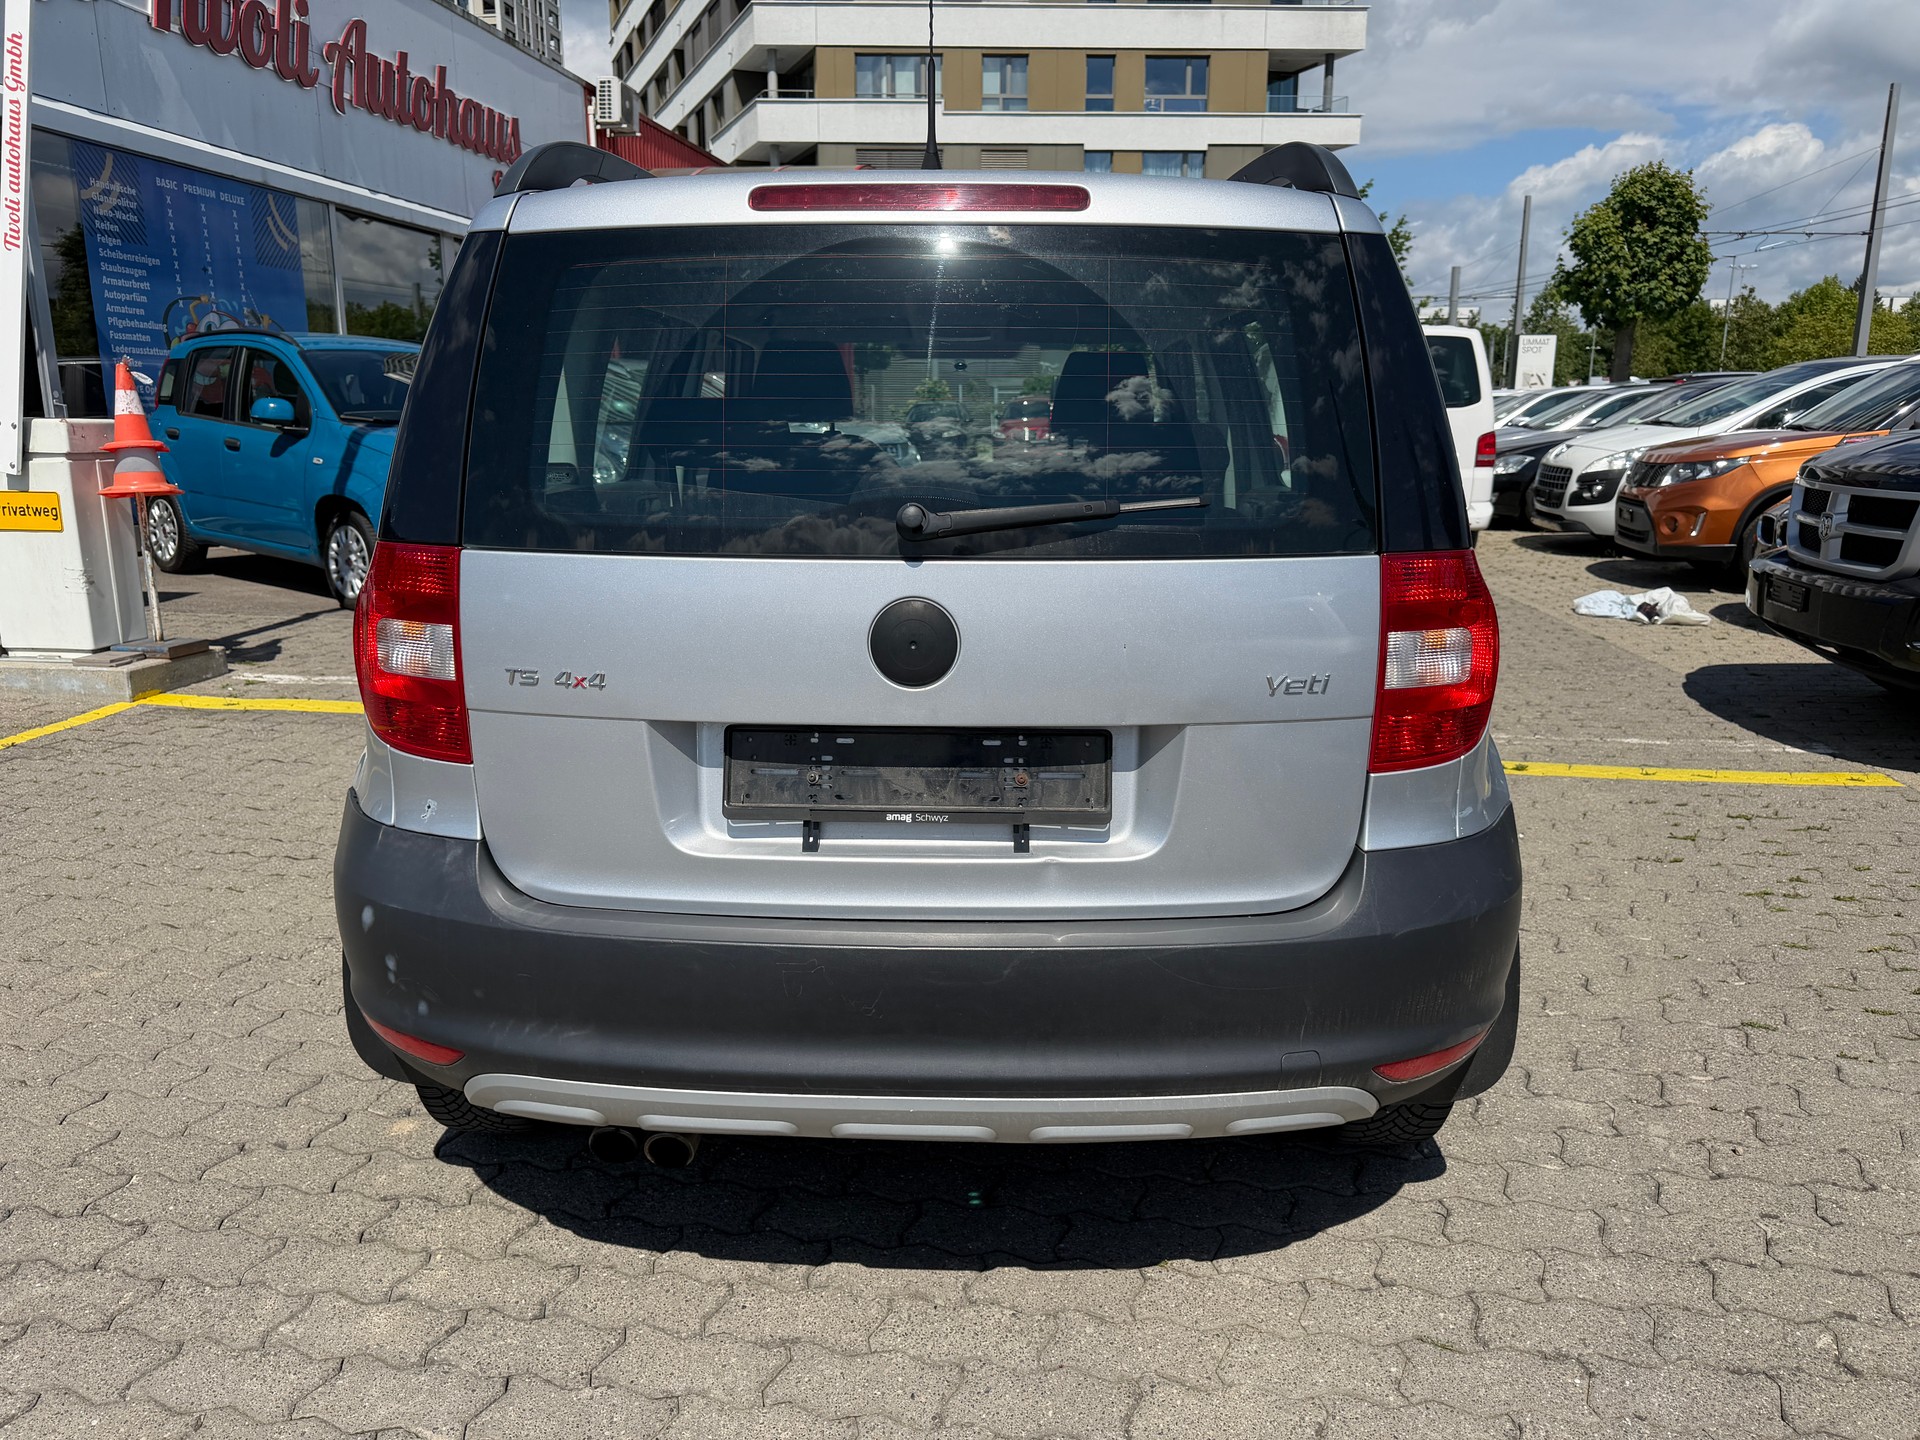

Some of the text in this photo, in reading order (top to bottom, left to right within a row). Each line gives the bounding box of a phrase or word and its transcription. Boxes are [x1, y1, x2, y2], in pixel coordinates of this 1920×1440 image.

[323, 18, 523, 166] Autohaus
[3, 31, 26, 252] Tivoli autohaus Gmbh
[90, 177, 136, 196] Handwäsche
[155, 177, 245, 206] BASIC PREMIUM DELUXE
[91, 192, 137, 209] Glanzpolitur
[93, 205, 138, 222] Nano-Wachs
[95, 220, 119, 232] Reifen
[97, 233, 122, 246] Felgen
[99, 247, 160, 266] Scheibenreinigen
[100, 262, 147, 277] Staubsaugen
[102, 276, 151, 290] Armaturbrett
[104, 289, 148, 303] Autoparfüm
[106, 303, 145, 316] Armaturen
[109, 330, 151, 342] Fussmatten
[1521, 346, 1543, 354] SPOT
[0, 502, 59, 521] rivatweg
[554, 669, 606, 691] 4x4
[1265, 672, 1331, 697] Yeti
[886, 813, 949, 823] amag Schwyz
